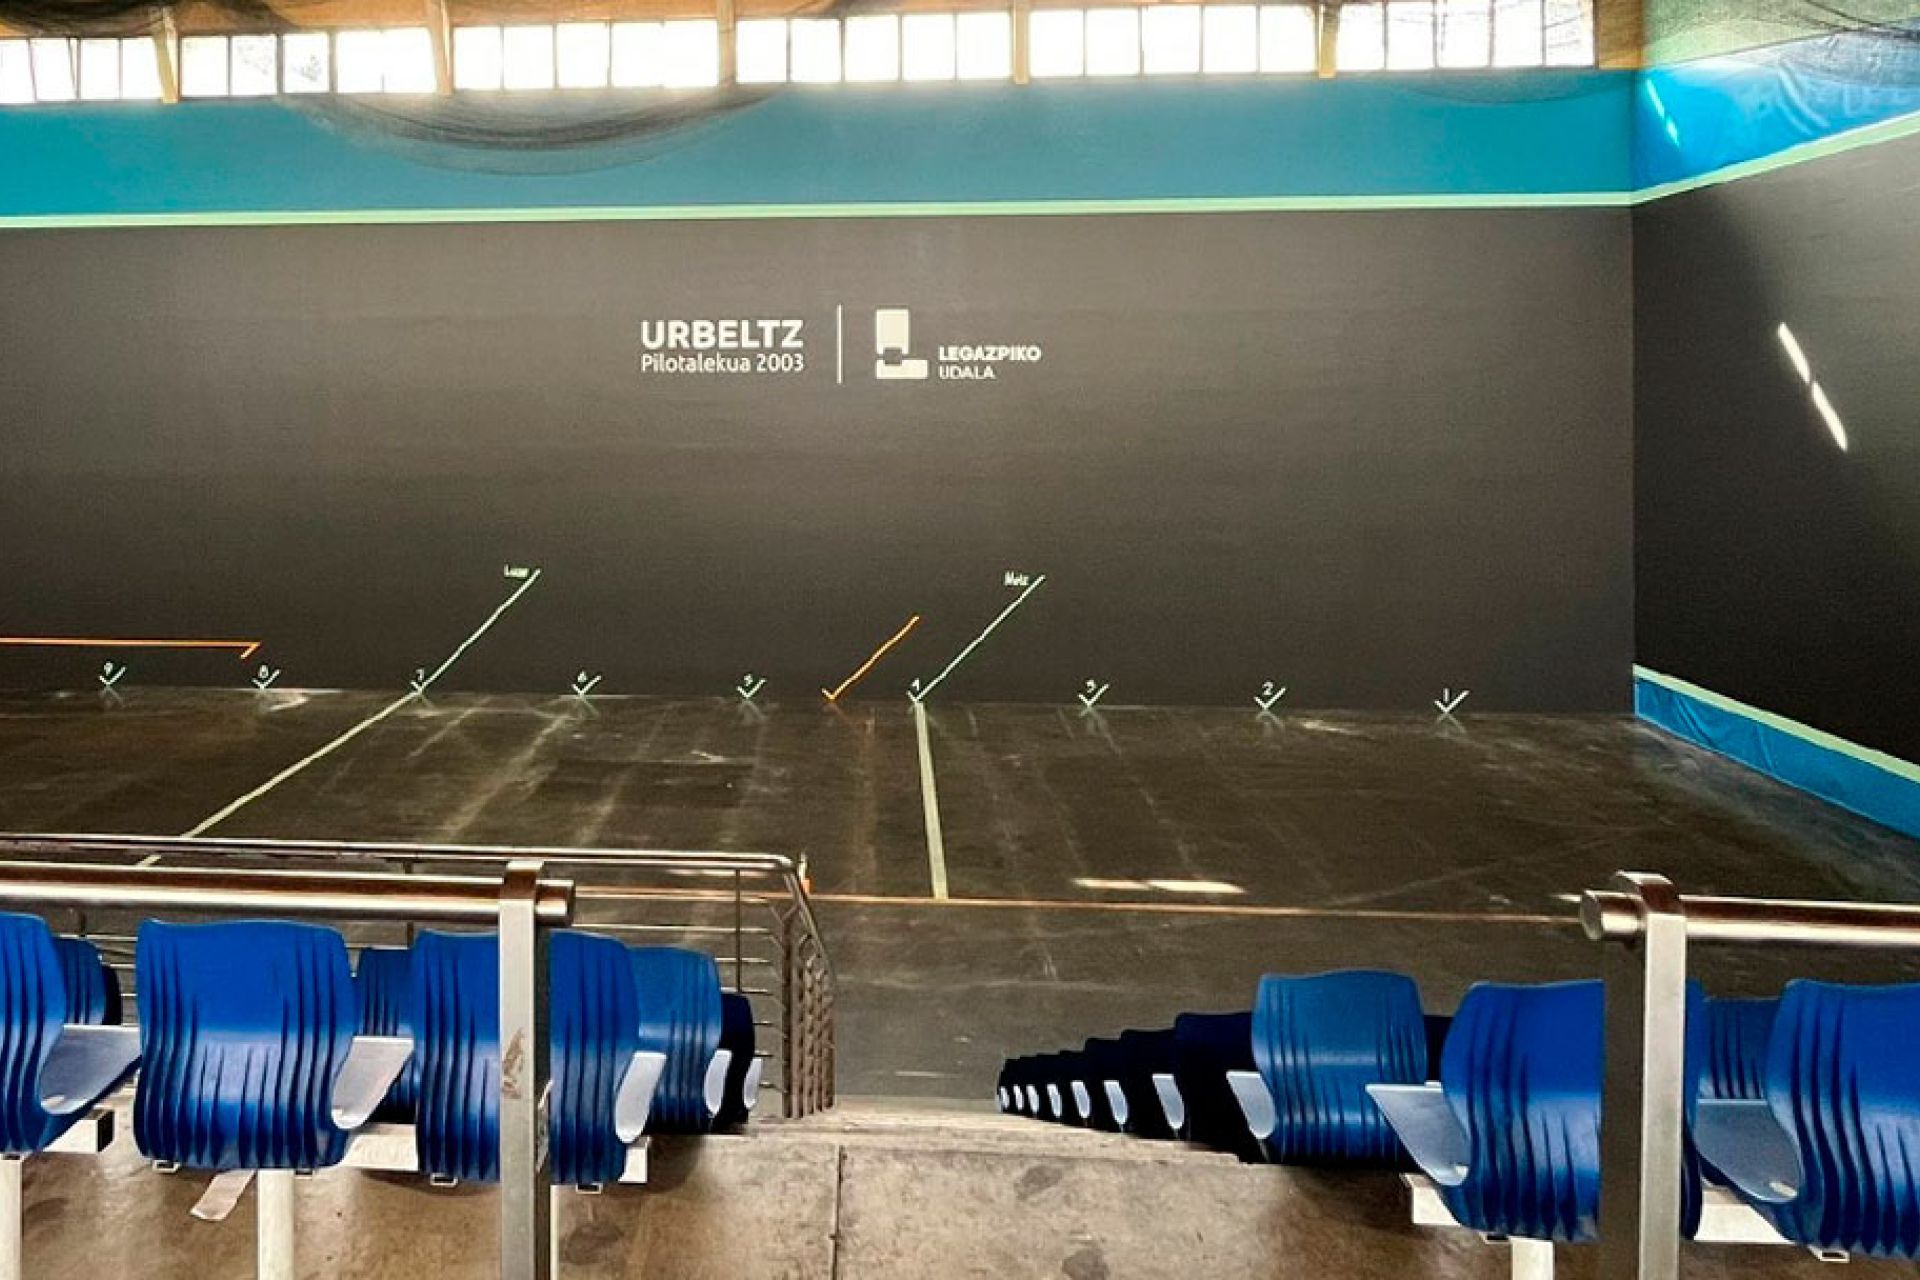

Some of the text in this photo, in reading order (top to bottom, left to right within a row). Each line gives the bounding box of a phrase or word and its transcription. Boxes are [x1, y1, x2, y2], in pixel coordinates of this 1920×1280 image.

[641, 320, 804, 349] URBELTZ
[939, 345, 1042, 362] LEGAZPIKO
[641, 353, 804, 374] Pilotalekua 2003
[939, 365, 995, 380] UDALA
[1263, 681, 1273, 695] 2
